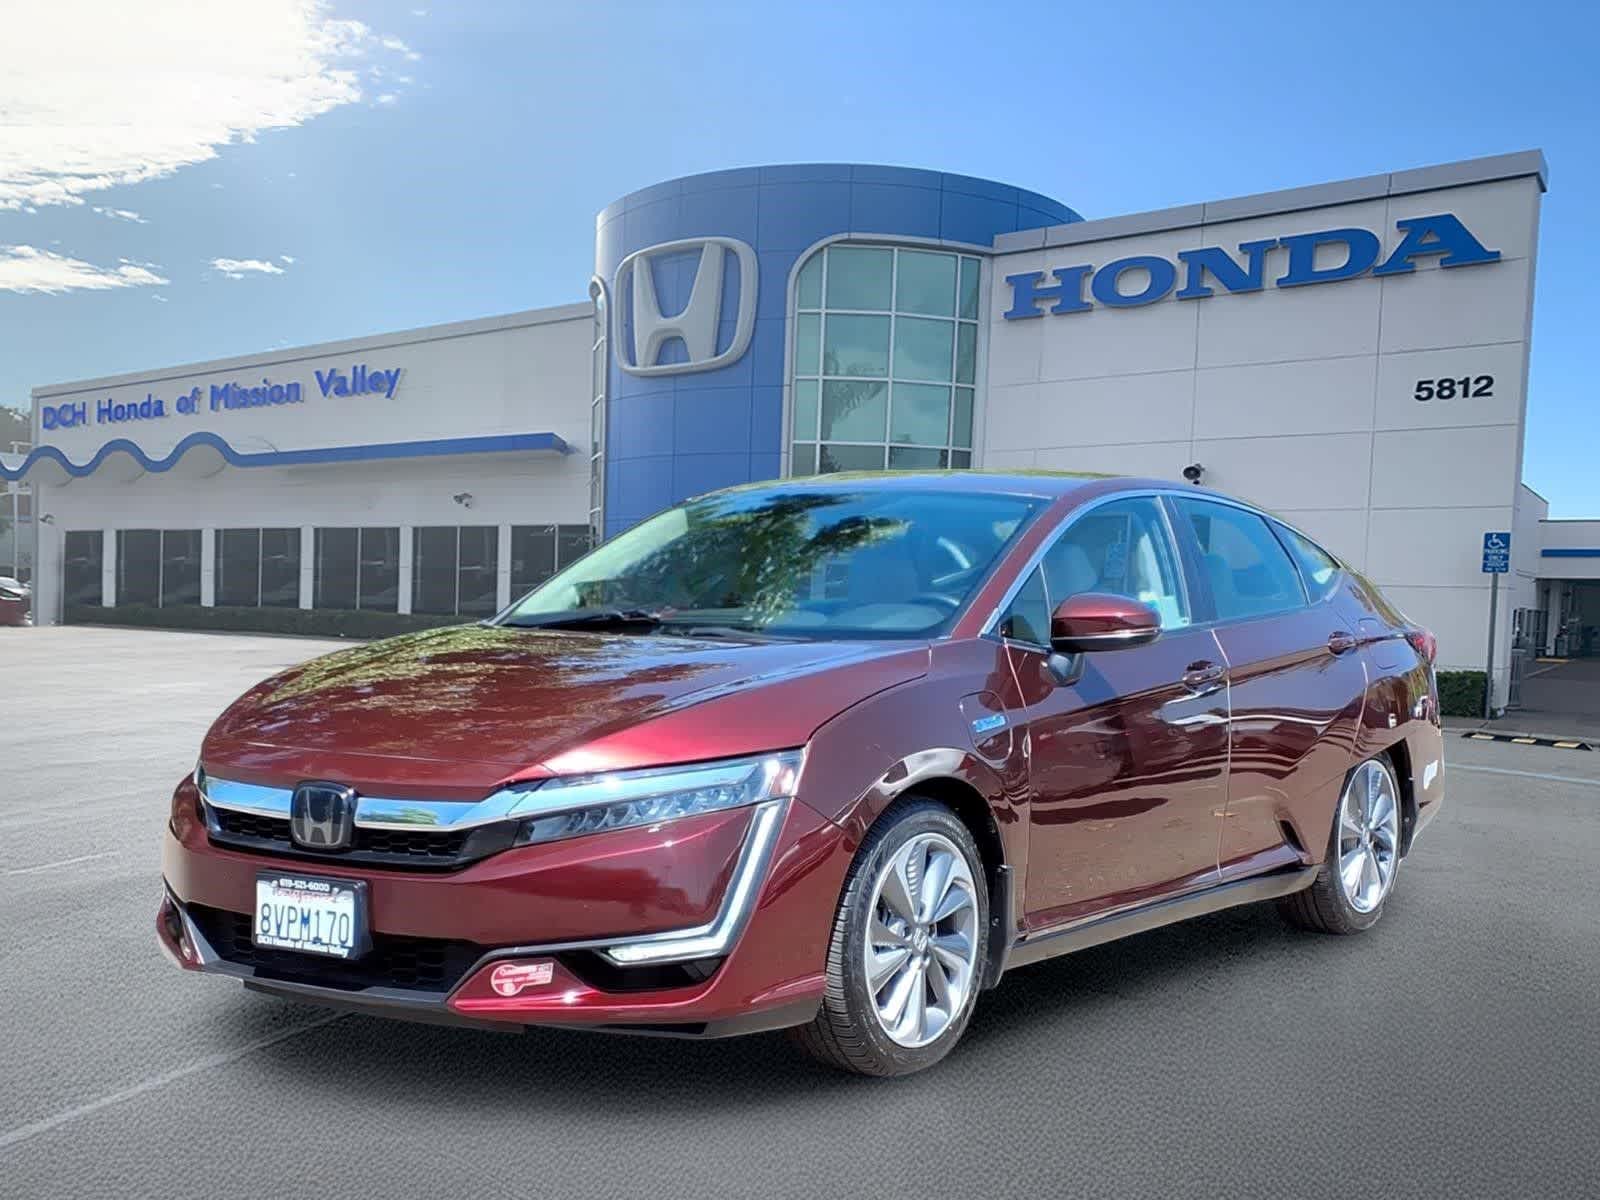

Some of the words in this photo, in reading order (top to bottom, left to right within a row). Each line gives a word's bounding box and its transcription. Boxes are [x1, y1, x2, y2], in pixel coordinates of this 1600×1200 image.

[1004, 213, 1501, 321] HONDA
[42, 401, 87, 430] DCH
[97, 394, 166, 424] Honda
[175, 386, 204, 414] of
[209, 378, 304, 412] Mission
[313, 363, 401, 400] Valley
[1414, 375, 1494, 402] 5812
[260, 902, 350, 946] 8VPM170
